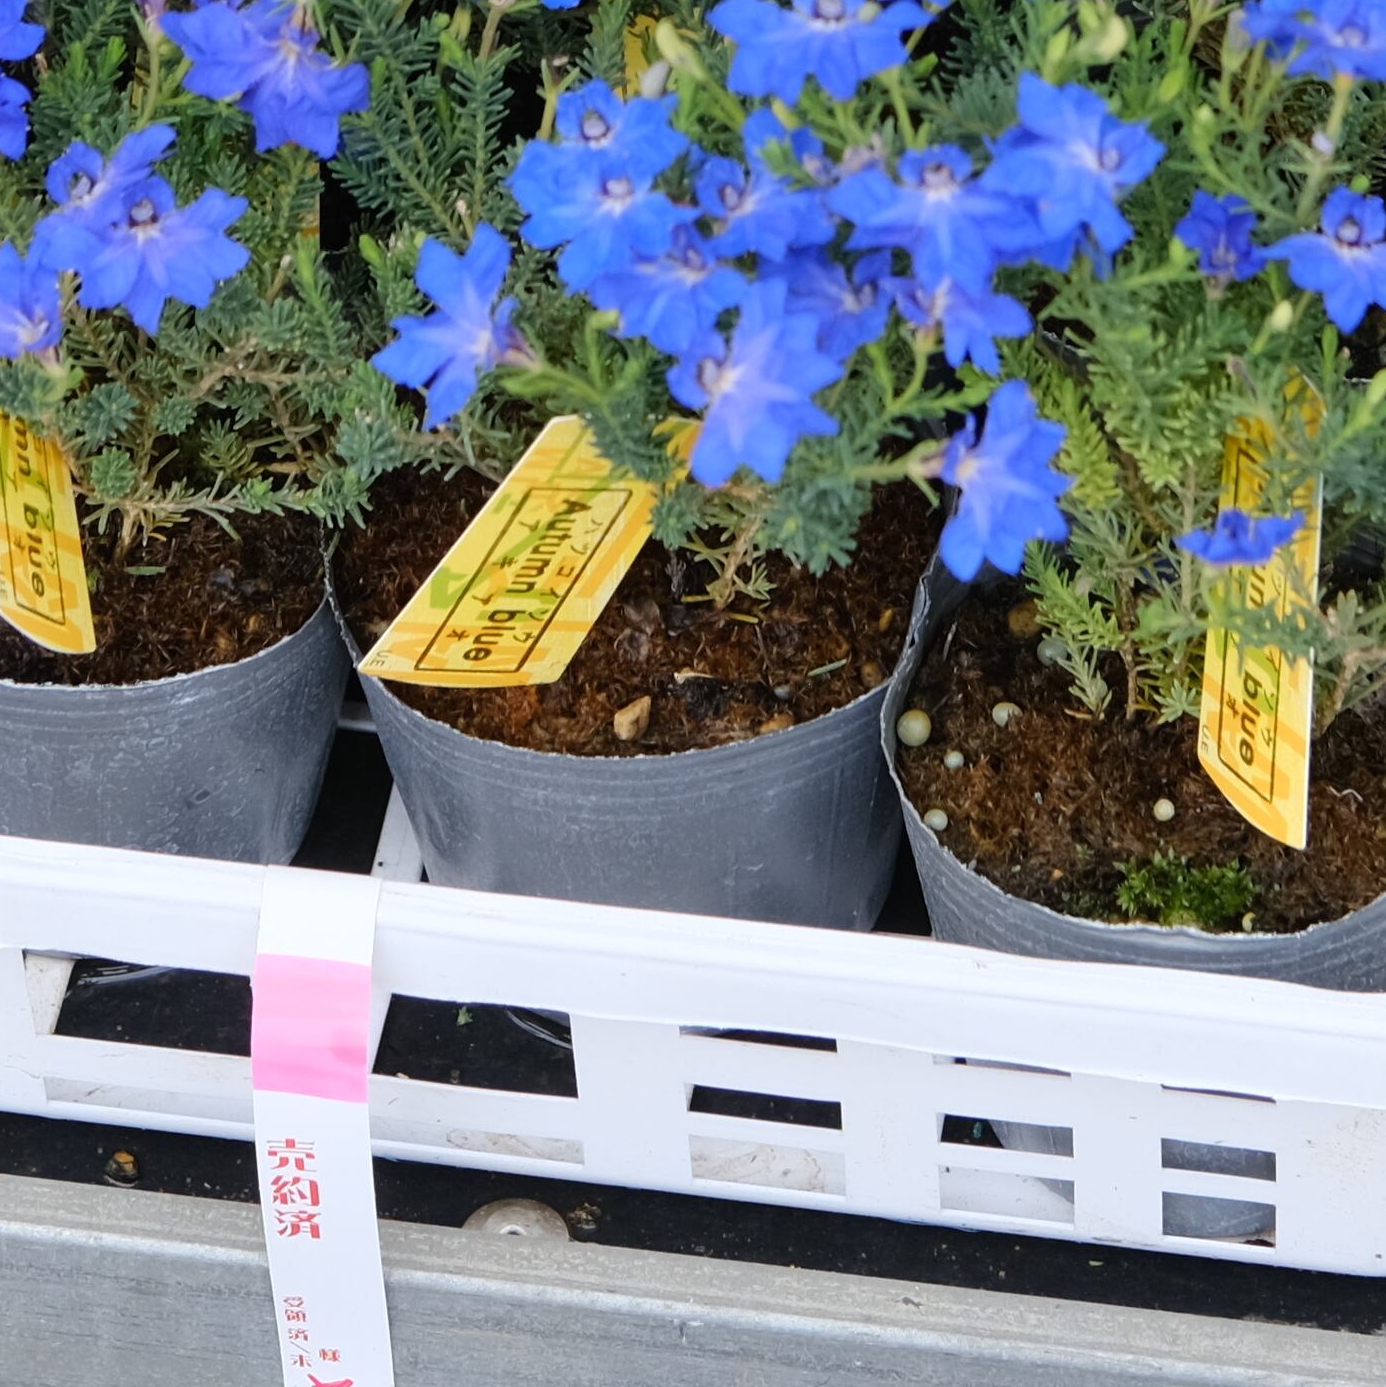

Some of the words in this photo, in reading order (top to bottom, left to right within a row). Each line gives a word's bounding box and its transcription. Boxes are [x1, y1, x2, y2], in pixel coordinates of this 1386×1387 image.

[23, 503, 45, 598] blue
[510, 498, 592, 594] Autumn
[462, 609, 518, 663] blue
[1239, 670, 1263, 767] blue
[266, 1138, 321, 1239] 売約済
